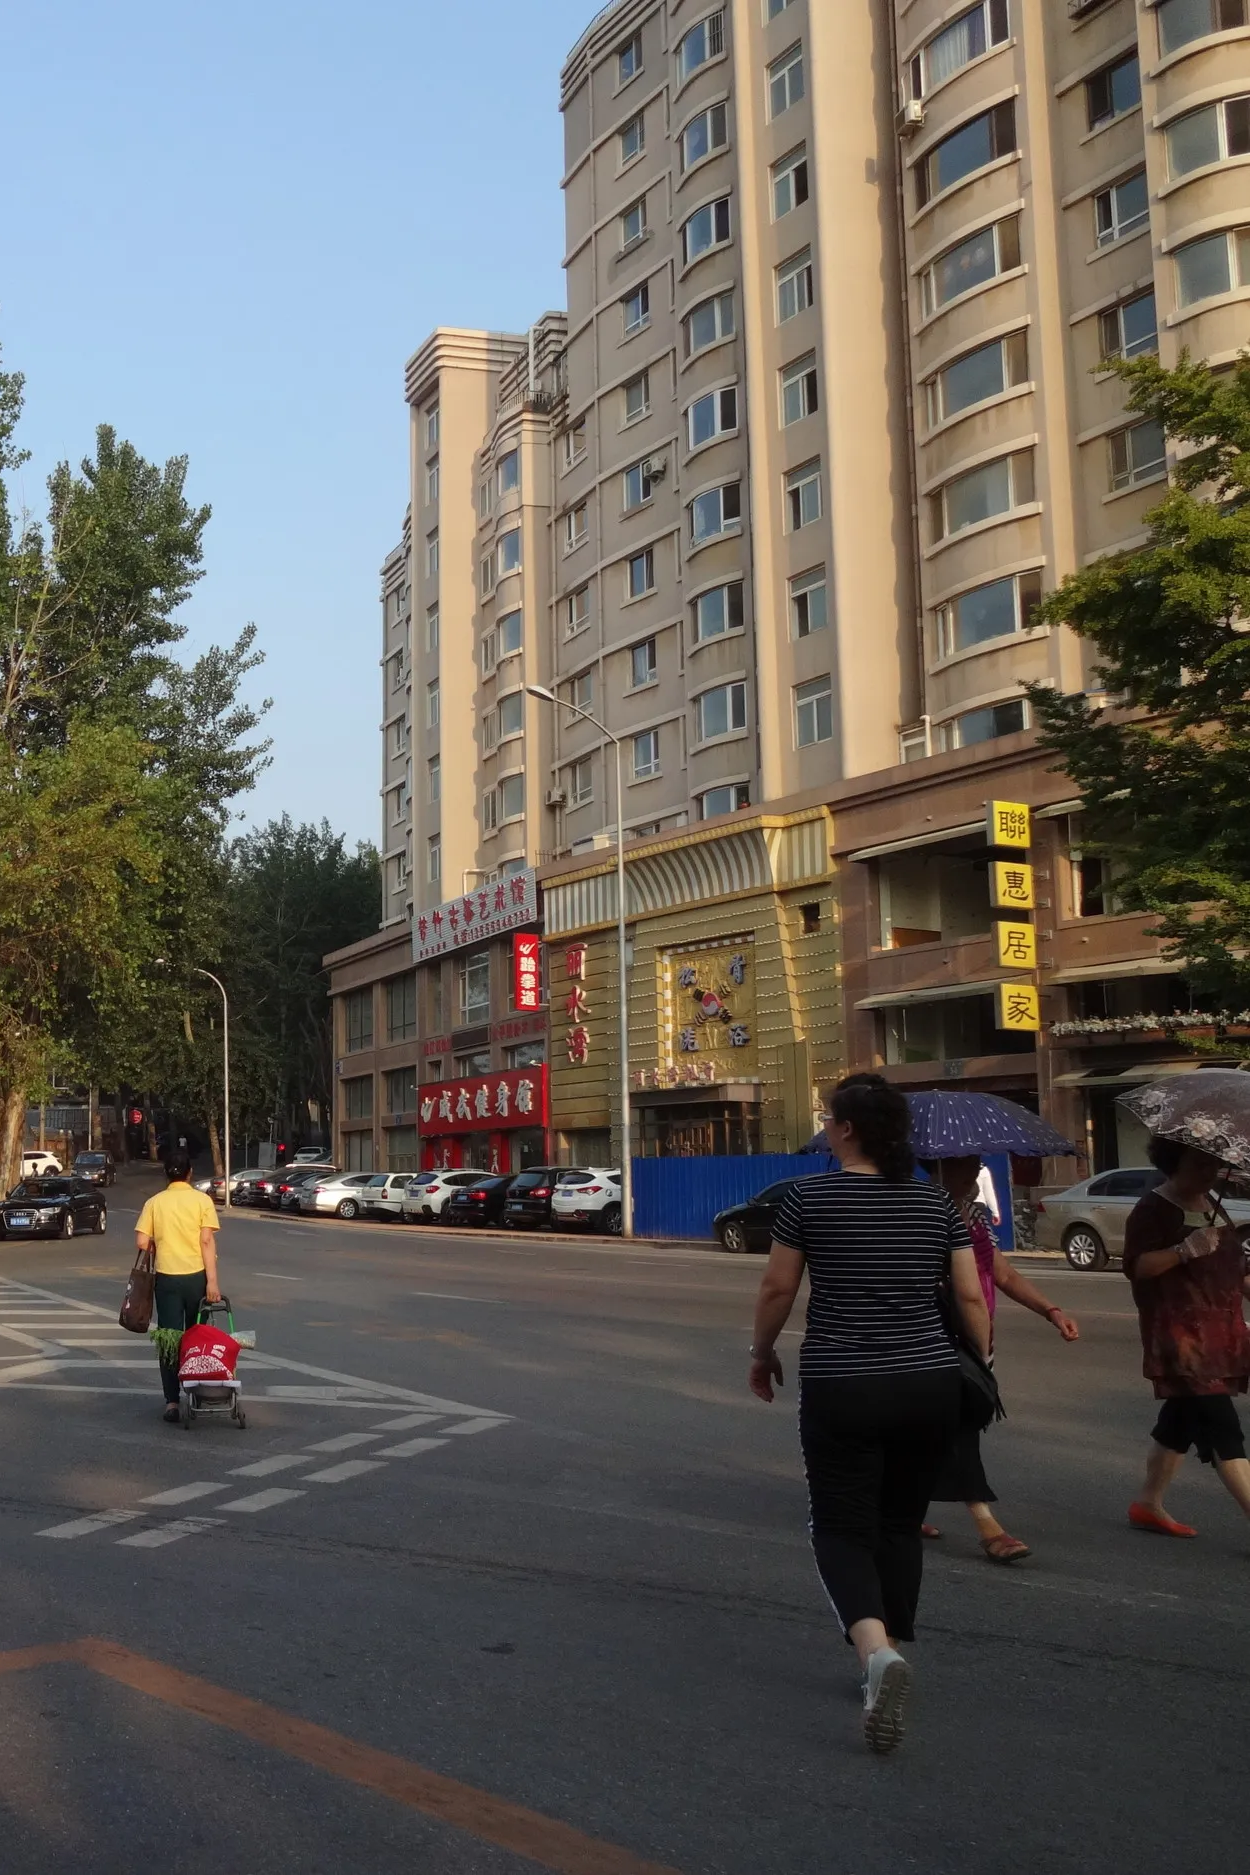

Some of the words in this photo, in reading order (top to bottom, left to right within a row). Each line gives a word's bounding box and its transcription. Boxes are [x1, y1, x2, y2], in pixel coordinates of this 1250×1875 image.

[997, 809, 1037, 1024] 聯惠居家
[519, 957, 537, 1007] 跆拳道
[565, 942, 592, 1065] 丽水湾
